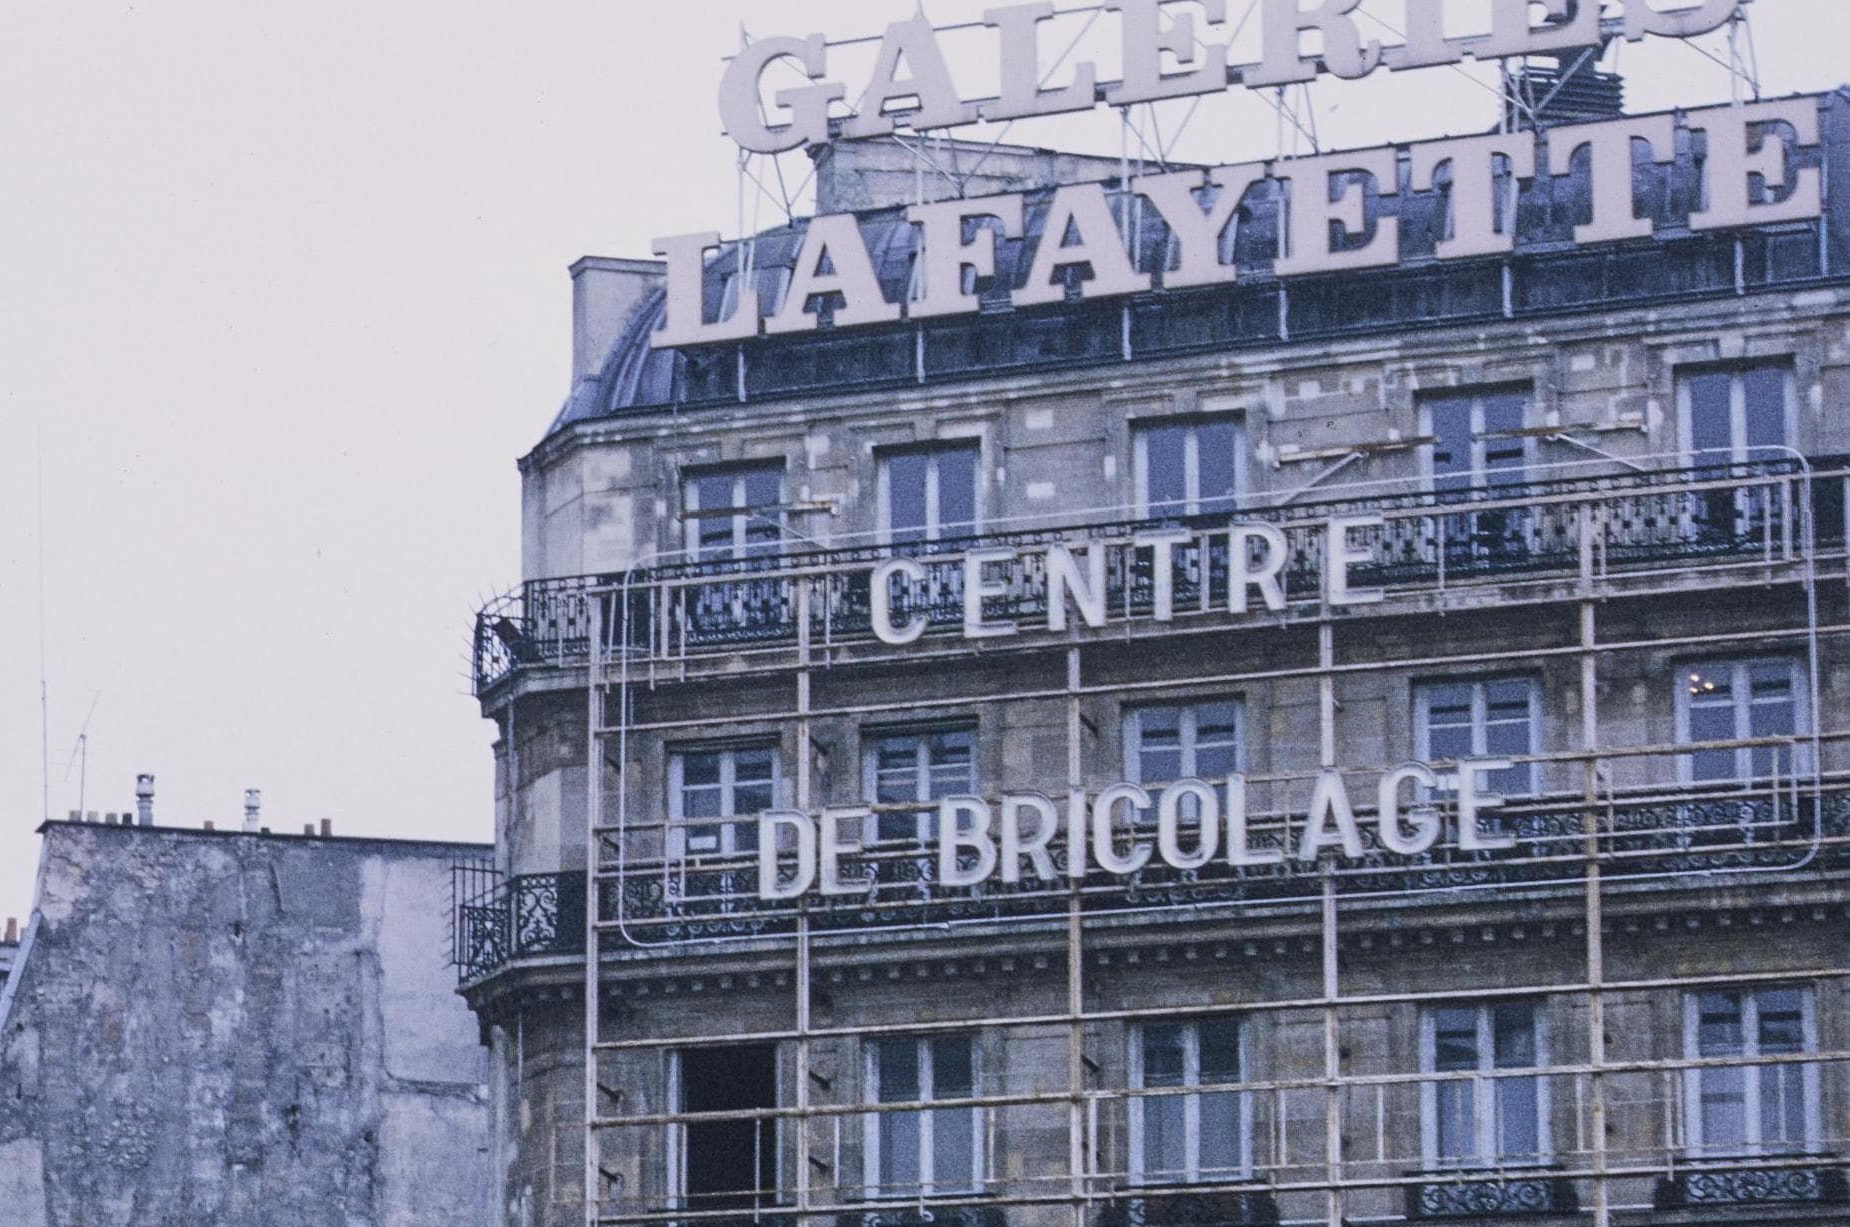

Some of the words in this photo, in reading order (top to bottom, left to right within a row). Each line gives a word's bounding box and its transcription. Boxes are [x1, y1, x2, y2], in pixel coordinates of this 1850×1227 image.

[651, 98, 1822, 348] LAFAYETTE
[869, 513, 1385, 646] CENTRE
[758, 806, 874, 900] DE
[938, 755, 1518, 888] BRICOLAGE
